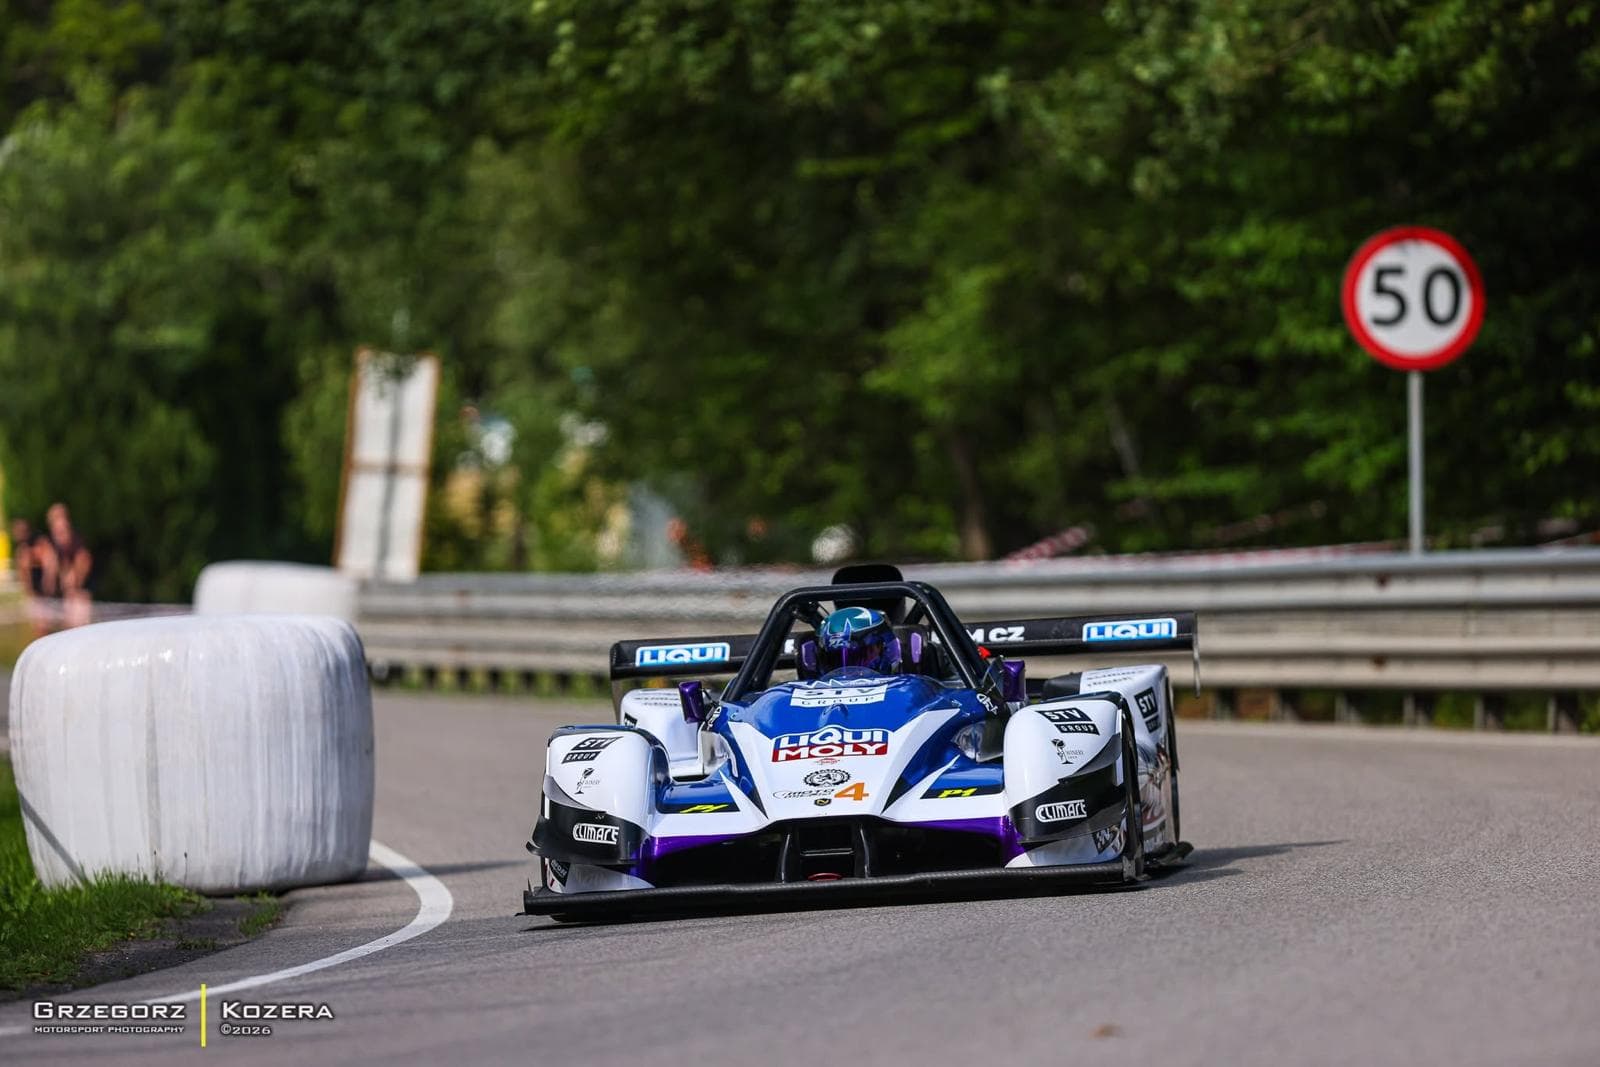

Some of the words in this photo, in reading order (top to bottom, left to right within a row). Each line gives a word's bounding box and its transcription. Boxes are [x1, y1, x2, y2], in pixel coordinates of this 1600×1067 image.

[1372, 265, 1461, 326] 50
[988, 626, 1025, 642] CZ
[1089, 621, 1170, 639] LIQUI
[643, 646, 723, 663] LIQUI
[1060, 724, 1095, 732] GROUP
[779, 727, 884, 749] LIQUI
[566, 752, 596, 761] GROUP
[777, 742, 887, 761] MOLY
[834, 782, 869, 801] 4
